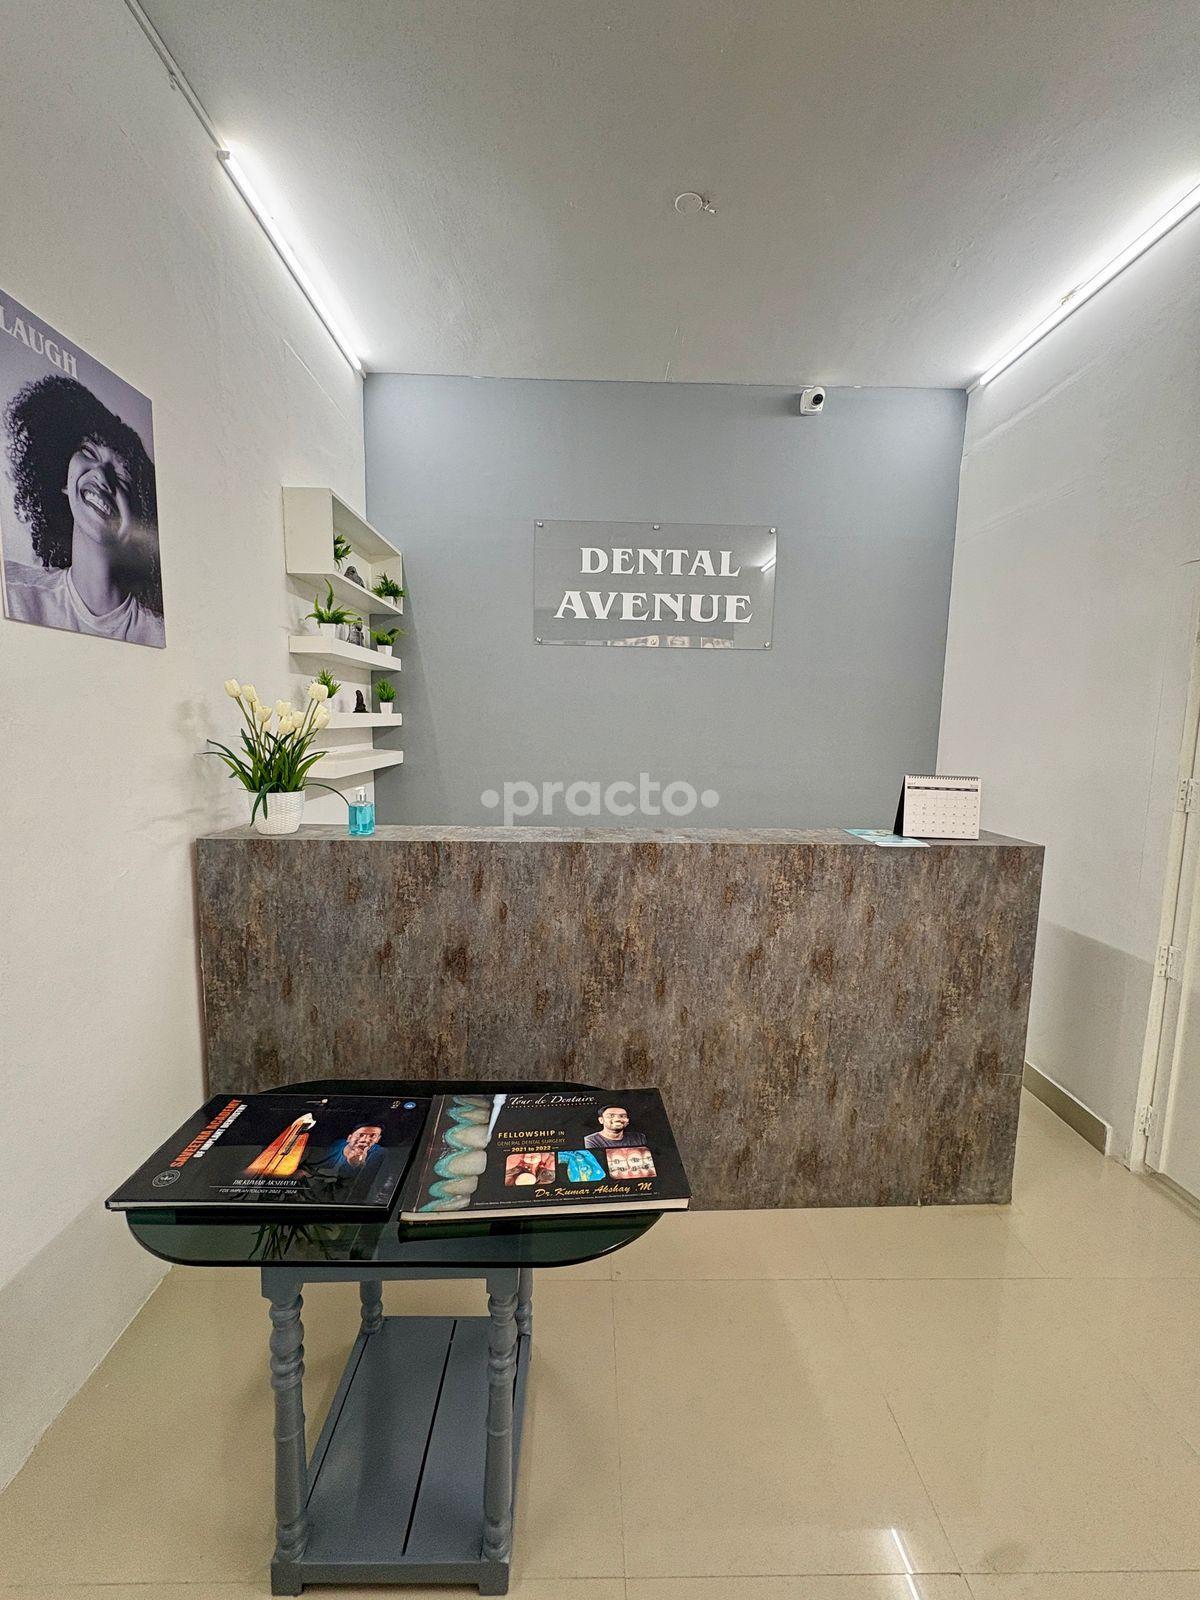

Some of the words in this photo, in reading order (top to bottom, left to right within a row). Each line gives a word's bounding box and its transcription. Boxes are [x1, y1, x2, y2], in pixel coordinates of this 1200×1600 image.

[0, 305, 79, 380] LAUGH
[579, 547, 742, 578] DENTAL
[553, 590, 753, 624] AVENUE
[509, 1095, 534, 1106] Tour
[534, 1093, 550, 1104] de
[550, 1095, 596, 1104] Dentaire
[169, 1129, 215, 1168] SAVEETHA
[205, 1098, 243, 1130] ACADEMY
[496, 1139, 521, 1147] GENERAL
[521, 1138, 541, 1146] DENTAL
[497, 1129, 556, 1139] FELLOWSHIP
[592, 1183, 631, 1195] Akshay
